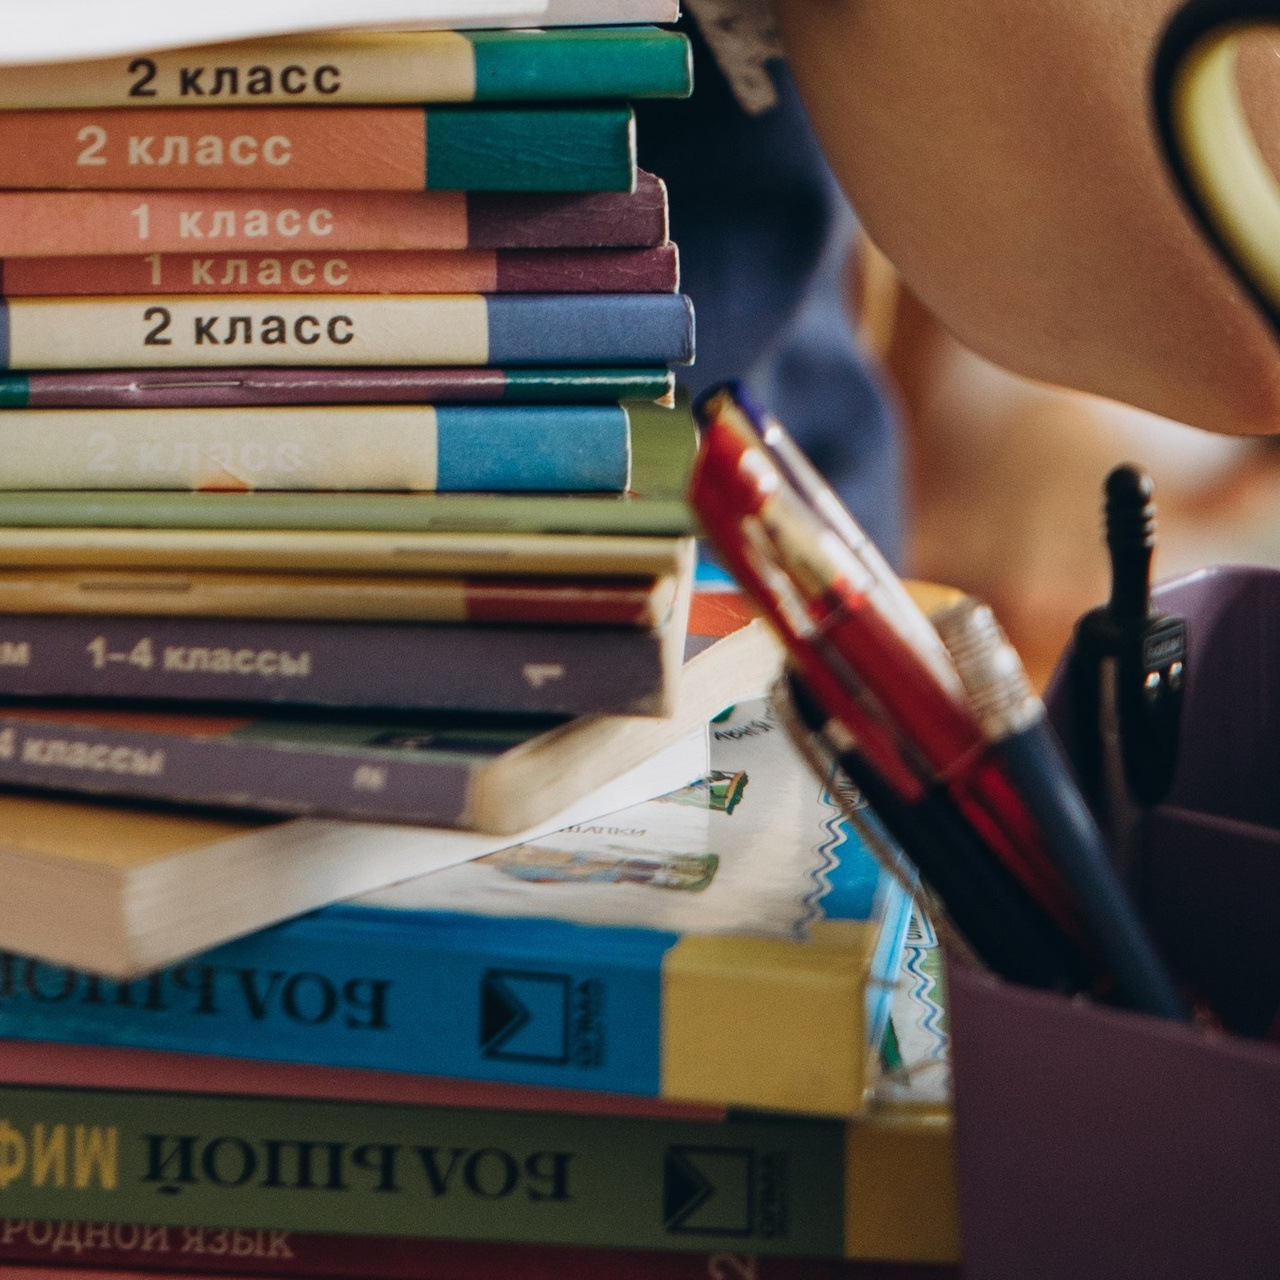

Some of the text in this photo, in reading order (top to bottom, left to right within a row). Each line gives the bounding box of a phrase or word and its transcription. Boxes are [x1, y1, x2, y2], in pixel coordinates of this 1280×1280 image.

[127, 59, 158, 97] 2
[179, 64, 341, 96] класс
[75, 125, 109, 167] 2
[127, 134, 292, 166] класс
[131, 203, 152, 240] 1
[179, 207, 334, 238] класс
[142, 253, 164, 287] 1
[191, 258, 349, 287] класс
[142, 306, 174, 346] 2
[193, 314, 355, 345] класс
[163, 643, 311, 679] классы
[21, 737, 165, 776] классы
[139, 1132, 574, 1204] БОЛЬШОЙ
[180, 1224, 296, 1260] ЯЗЫК
